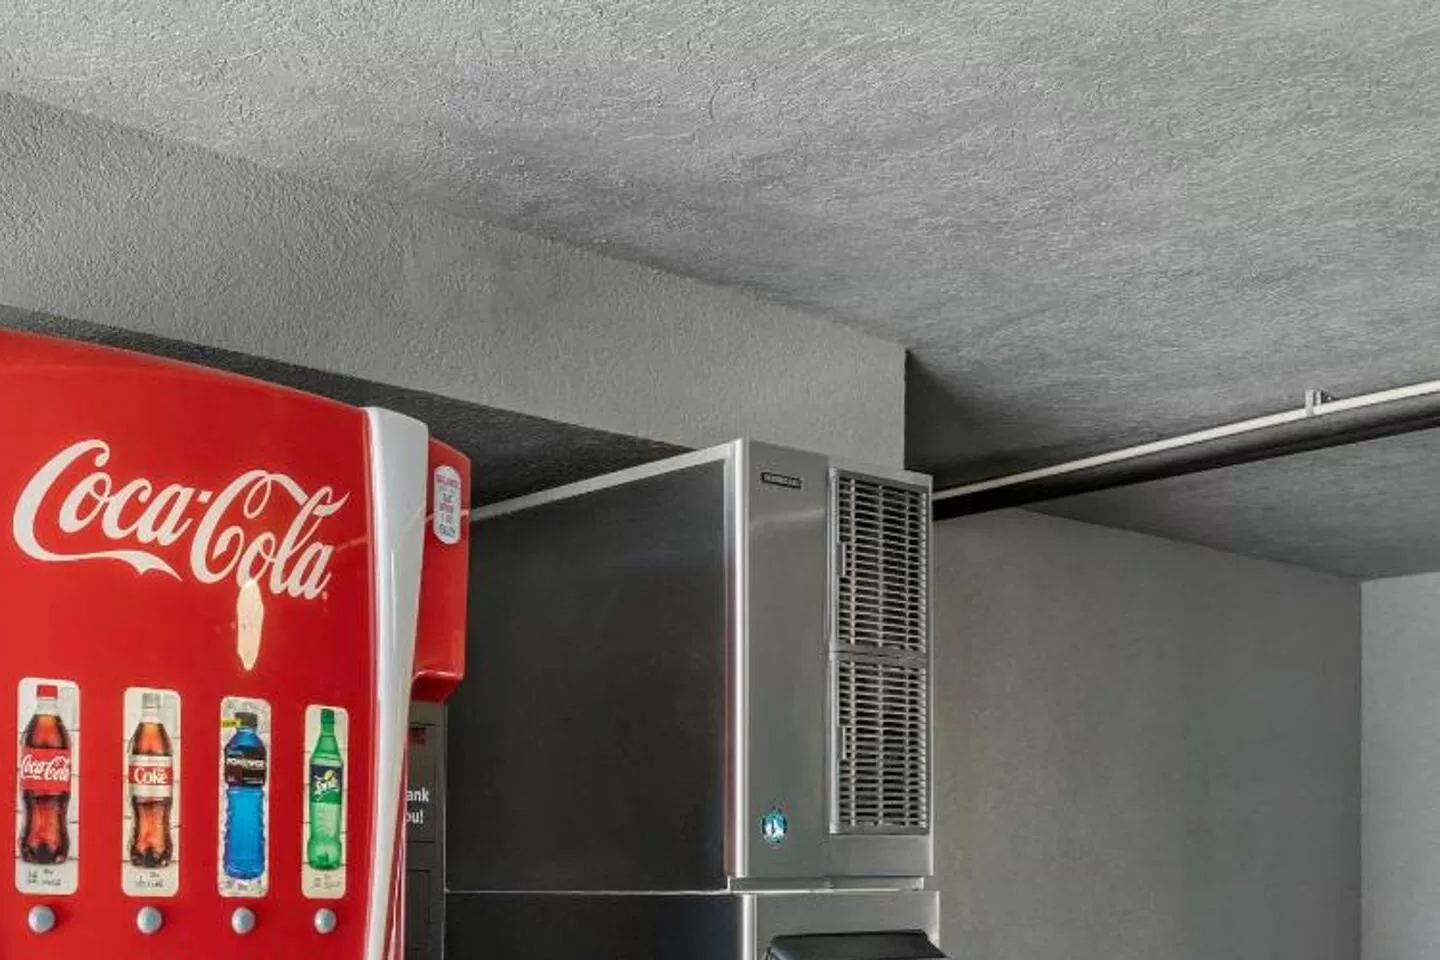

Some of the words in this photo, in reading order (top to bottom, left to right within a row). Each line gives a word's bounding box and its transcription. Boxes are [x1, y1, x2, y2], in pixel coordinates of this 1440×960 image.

[13, 438, 350, 600] Coca-Cola
[133, 767, 169, 785] Coke
[406, 786, 430, 802] ank
[406, 808, 424, 824] ou!
